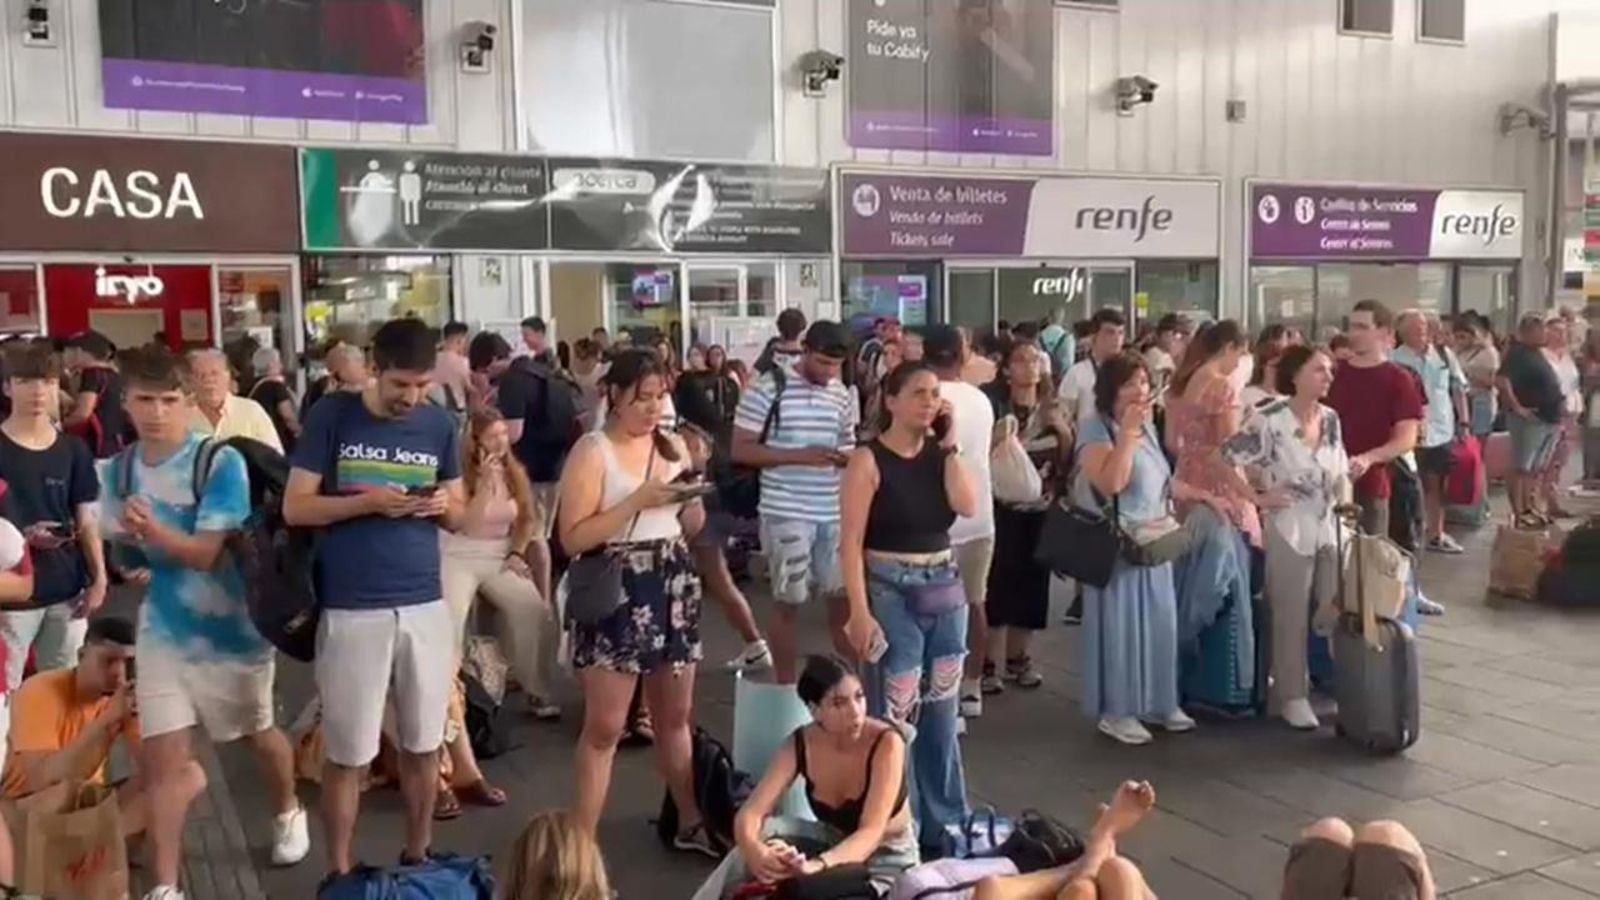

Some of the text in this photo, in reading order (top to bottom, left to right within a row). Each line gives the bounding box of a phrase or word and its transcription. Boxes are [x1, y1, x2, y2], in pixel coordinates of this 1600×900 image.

[866, 19, 917, 39] Pide ya
[867, 42, 930, 63] tu Cabify
[40, 166, 205, 220] CASA
[889, 184, 1009, 205] Venta de billetes
[927, 211, 942, 225] de
[1075, 194, 1174, 243] renfe
[1441, 203, 1516, 245] renfe
[890, 230, 955, 247] Tickets sale
[94, 267, 164, 304] iryo
[392, 446, 439, 466] Jeans
